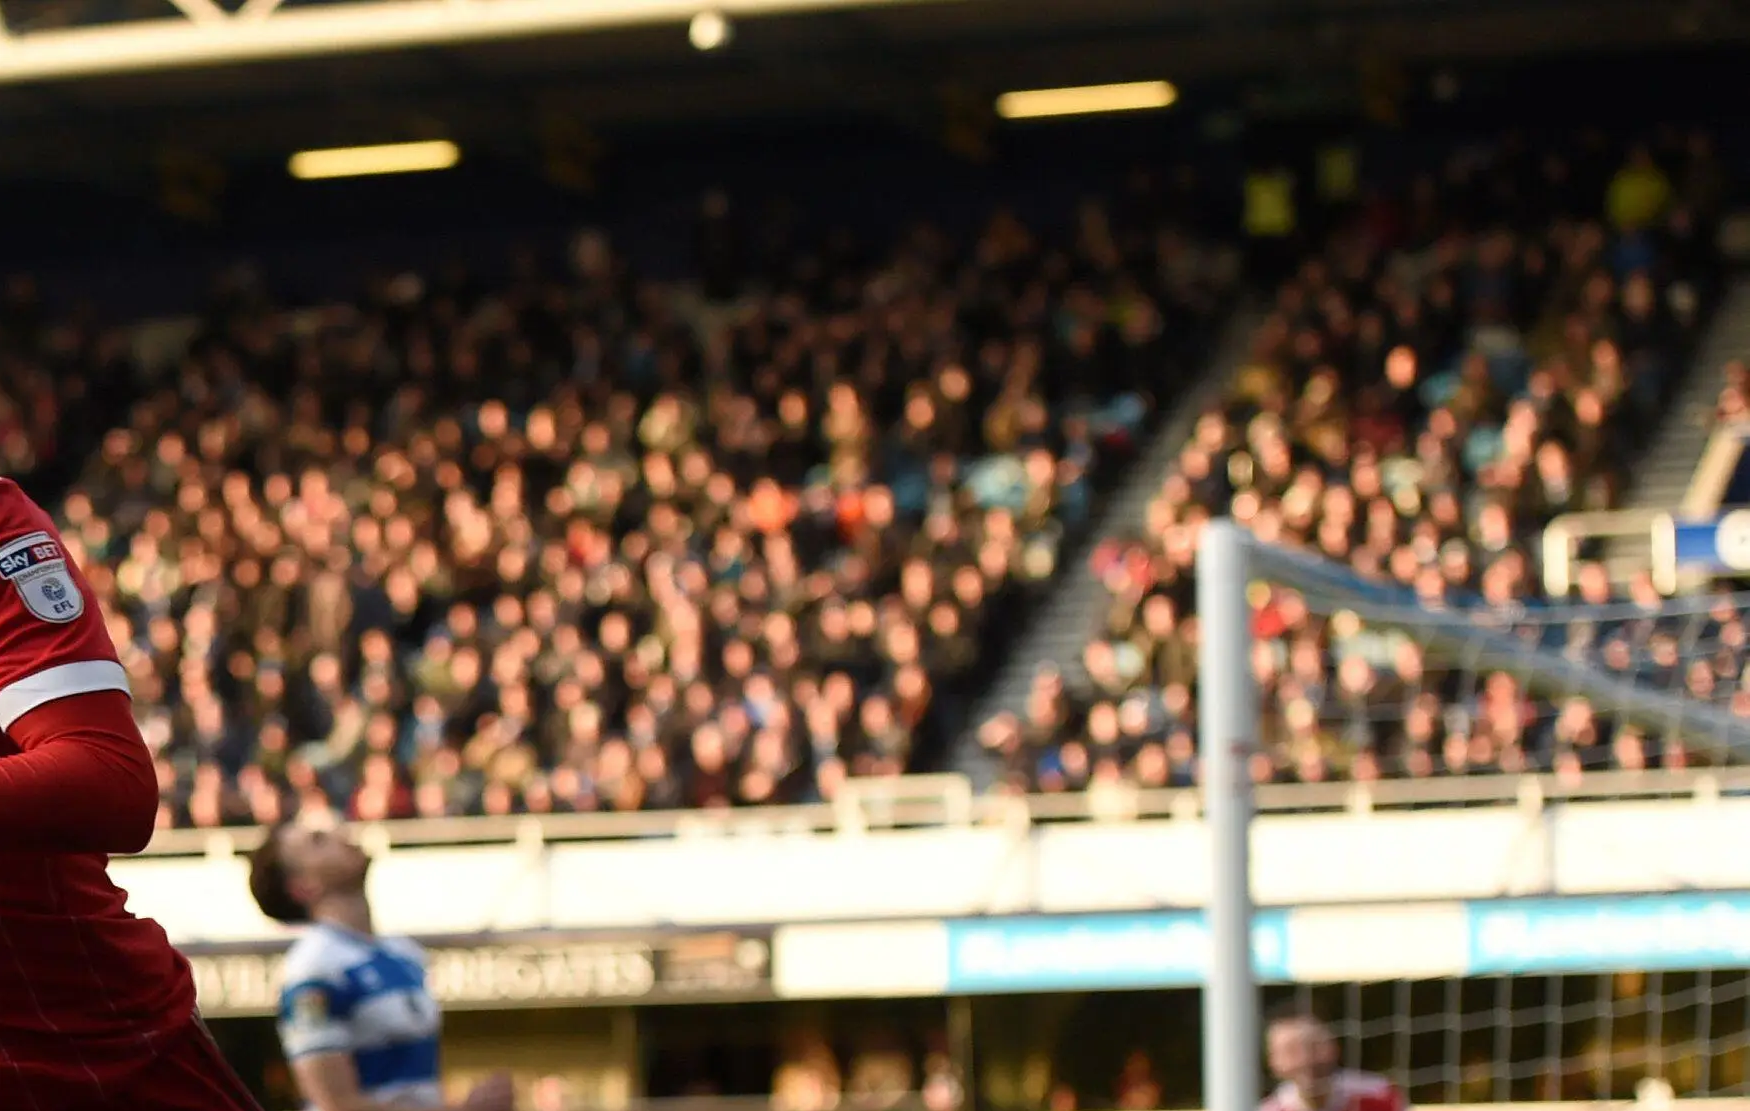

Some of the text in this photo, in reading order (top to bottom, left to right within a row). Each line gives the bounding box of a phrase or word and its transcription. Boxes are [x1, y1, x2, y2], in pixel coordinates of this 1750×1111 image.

[0, 543, 59, 573] sky BET
[53, 600, 74, 614] EFL
